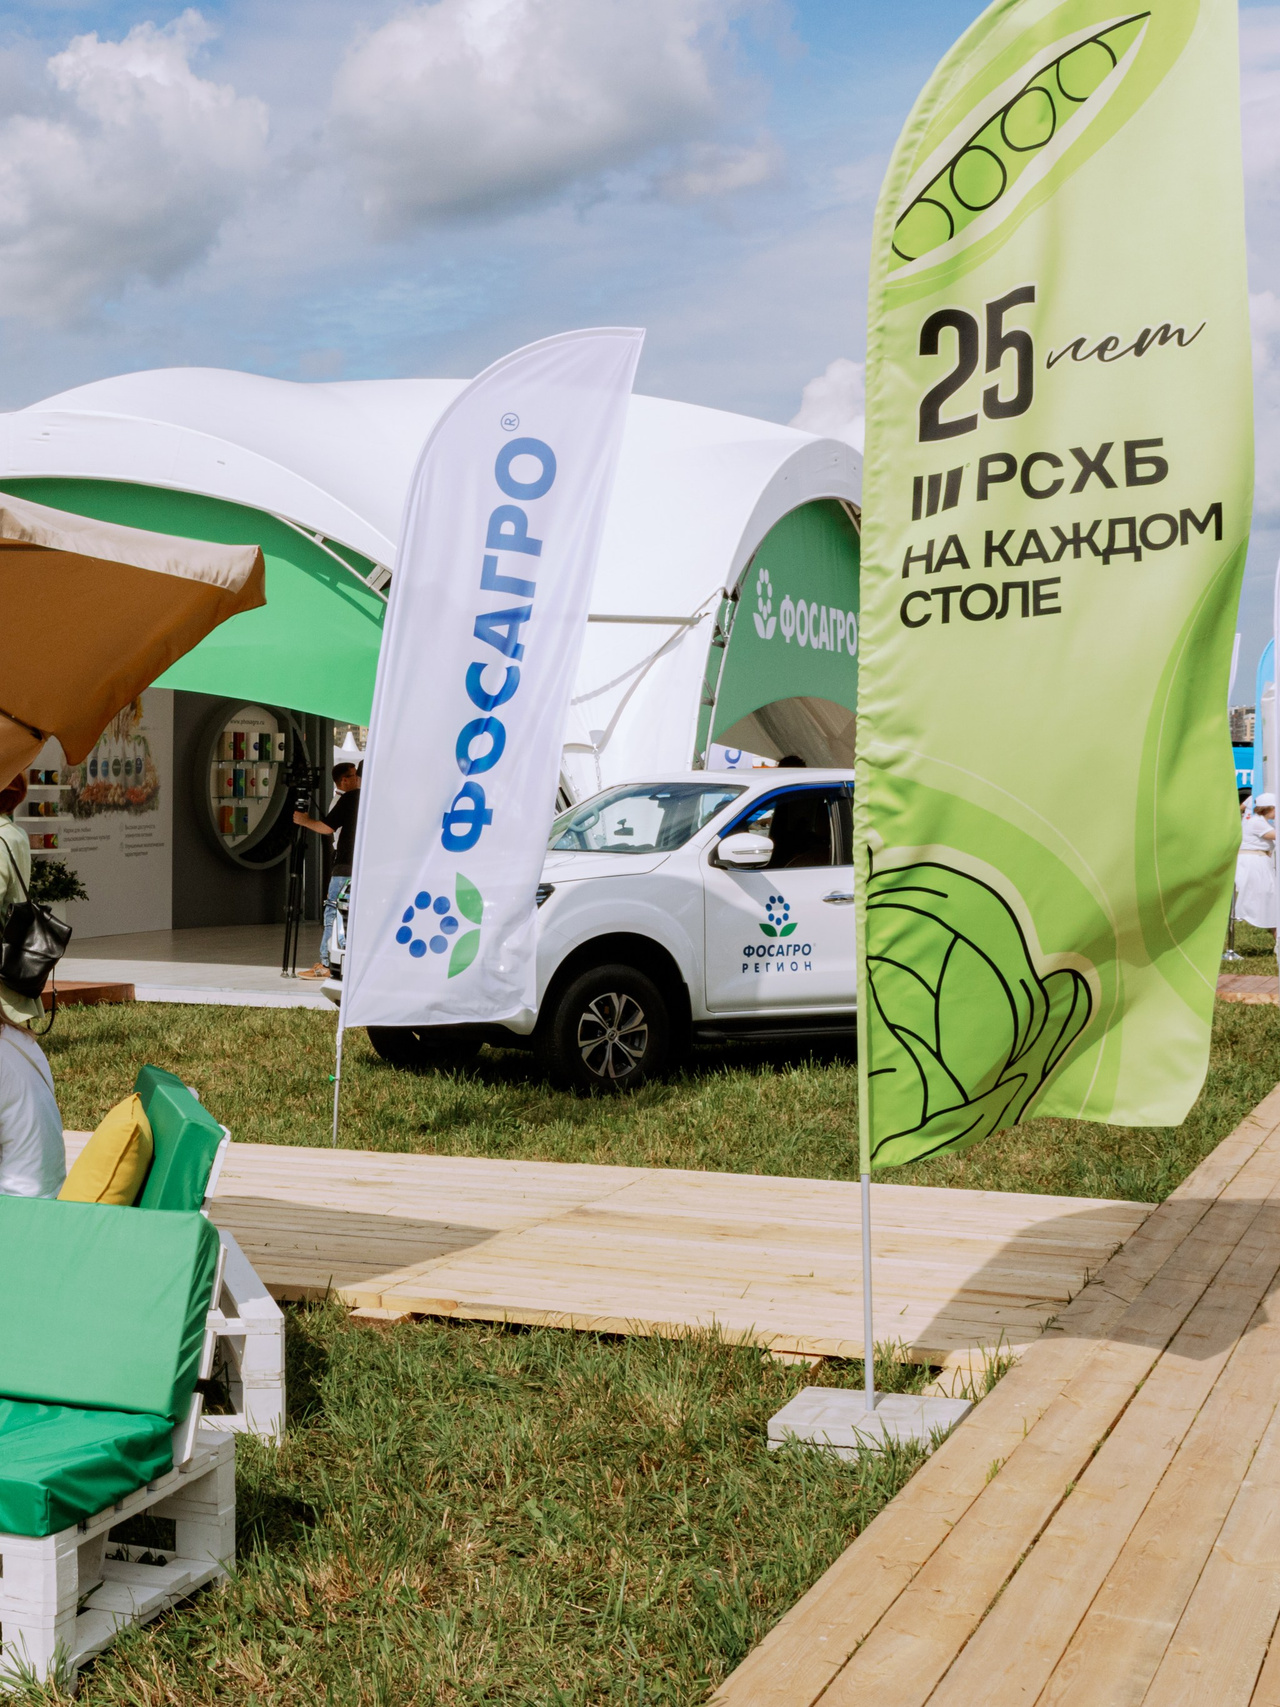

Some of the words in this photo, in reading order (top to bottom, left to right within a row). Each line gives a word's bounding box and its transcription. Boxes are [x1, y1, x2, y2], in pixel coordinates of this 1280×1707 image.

[918, 284, 1037, 443] 25
[1045, 320, 1209, 371] лет
[976, 436, 1170, 502] РСХБ
[901, 533, 971, 579] НА
[983, 501, 1223, 568] КАЖДОМ
[779, 593, 858, 658] ФОСАГРО
[899, 575, 1062, 629] СТОЛЕ
[741, 961, 812, 974] РЕГИОН
[742, 943, 812, 958] ФОСАГРО
